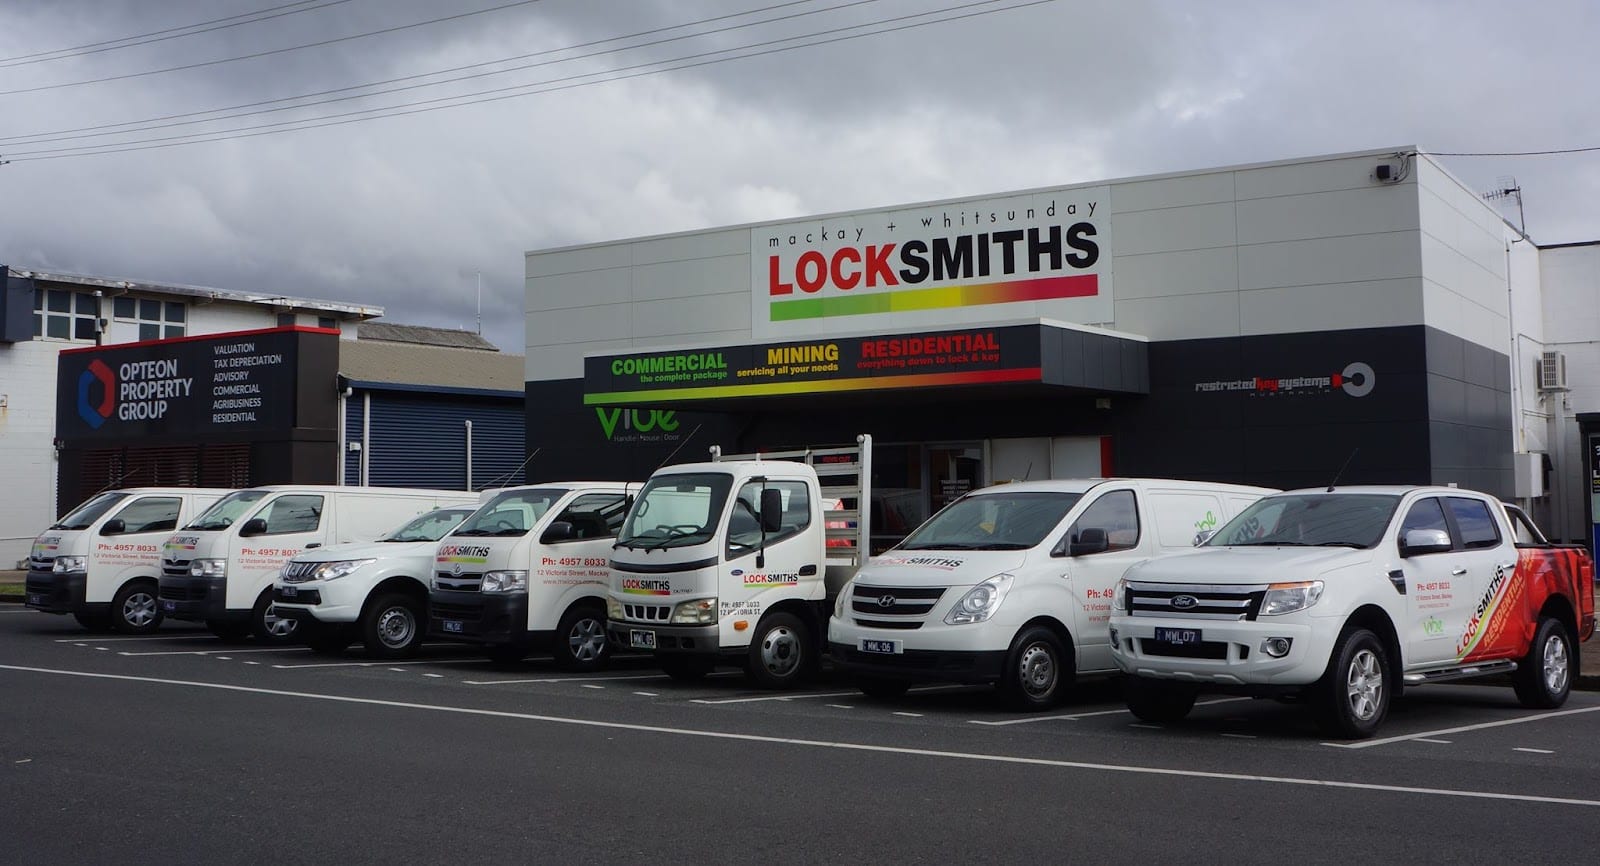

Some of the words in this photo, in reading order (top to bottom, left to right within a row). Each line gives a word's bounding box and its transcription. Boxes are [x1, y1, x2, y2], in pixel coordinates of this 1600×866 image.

[769, 226, 864, 247] mackay
[921, 200, 1097, 227] whitsunday
[769, 222, 1099, 295] LOCKSMITHS
[214, 343, 255, 355] VALUATION
[862, 333, 999, 358] RESIDENTIAL
[214, 359, 228, 368] TAX
[230, 354, 282, 368] DEPRECIATION
[767, 343, 839, 365] MINING
[857, 358, 905, 369] everything
[907, 356, 934, 366] down
[936, 356, 946, 365] to
[948, 354, 968, 364] lock
[981, 352, 1000, 364] key
[119, 359, 178, 381] OPTEON
[611, 353, 727, 376] COMMERCIAL
[737, 366, 775, 378] servicing
[777, 365, 788, 375] all
[790, 365, 809, 377] your
[811, 362, 839, 373] needs
[213, 371, 249, 382] ADVISORY
[640, 375, 652, 383] the
[654, 372, 691, 384] complete
[693, 370, 728, 382] package
[120, 378, 193, 400] PROPERTY
[213, 384, 261, 396] COMMERCIAL
[212, 397, 262, 409] AGRIBUSINESS
[118, 400, 168, 421] GROUP
[212, 412, 257, 423] RESIDENTIAL
[663, 433, 680, 441] Door
[98, 543, 112, 551] Ph:
[437, 545, 490, 557] LOCKSMITHS
[542, 557, 557, 565] Ph:
[559, 558, 581, 566] 4957
[584, 558, 606, 566] 8033
[588, 570, 609, 578] Mackay
[744, 573, 798, 583] LOCKSMITHS
[622, 579, 670, 590] LOCKSMITHS
[1087, 589, 1101, 598] Ph:
[1103, 589, 1113, 598] 49
[1457, 564, 1505, 656] LOCKSMITHS
[1483, 573, 1523, 648] RESIDENTIAL
